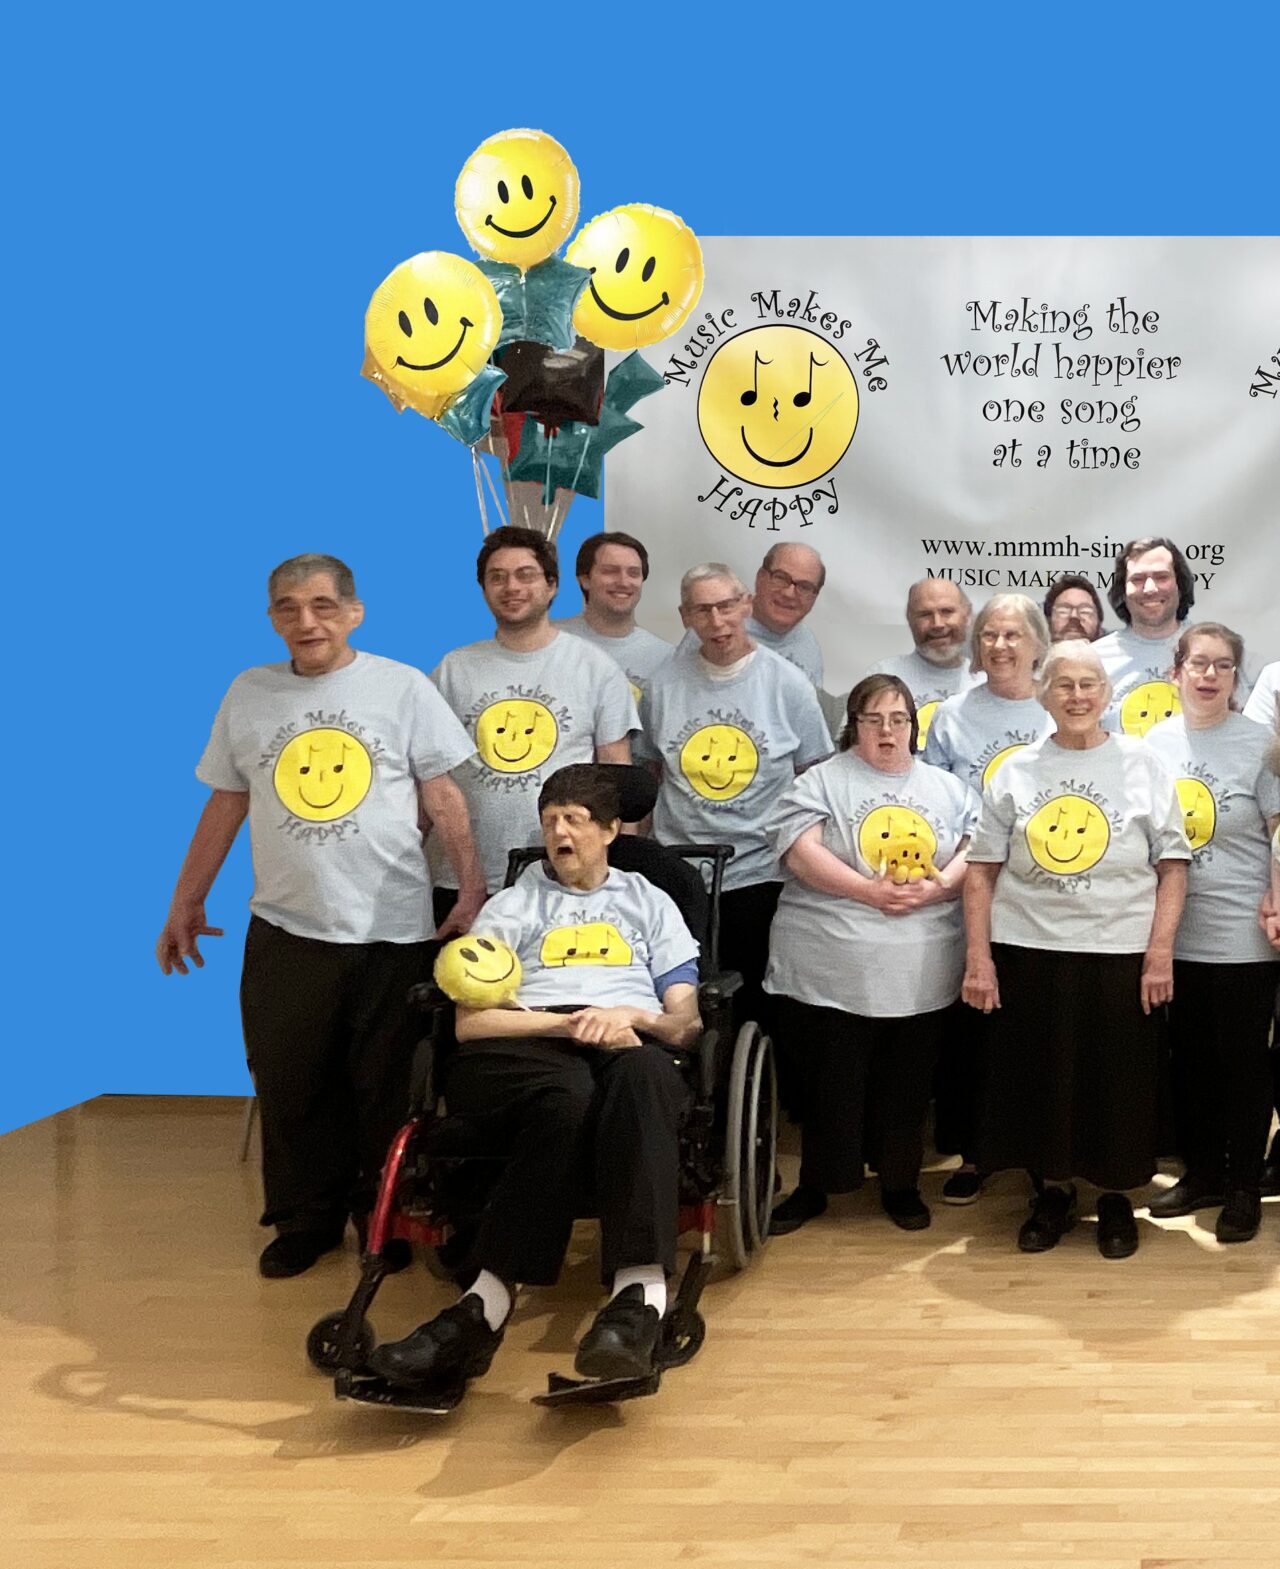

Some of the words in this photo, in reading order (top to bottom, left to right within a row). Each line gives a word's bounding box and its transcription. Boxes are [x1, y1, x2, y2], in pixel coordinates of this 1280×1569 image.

[965, 297, 1094, 340] Making
[1106, 297, 1160, 334] the
[662, 308, 737, 387] Music
[750, 289, 852, 339] Makes
[853, 338, 889, 392] Me
[940, 342, 1040, 380] world
[1052, 345, 1181, 386] happier
[982, 399, 1045, 423] one
[1060, 395, 1141, 432] song
[993, 437, 1022, 469] at
[1036, 445, 1051, 469] a
[1066, 438, 1142, 470] time
[1097, 571, 1118, 589] M
